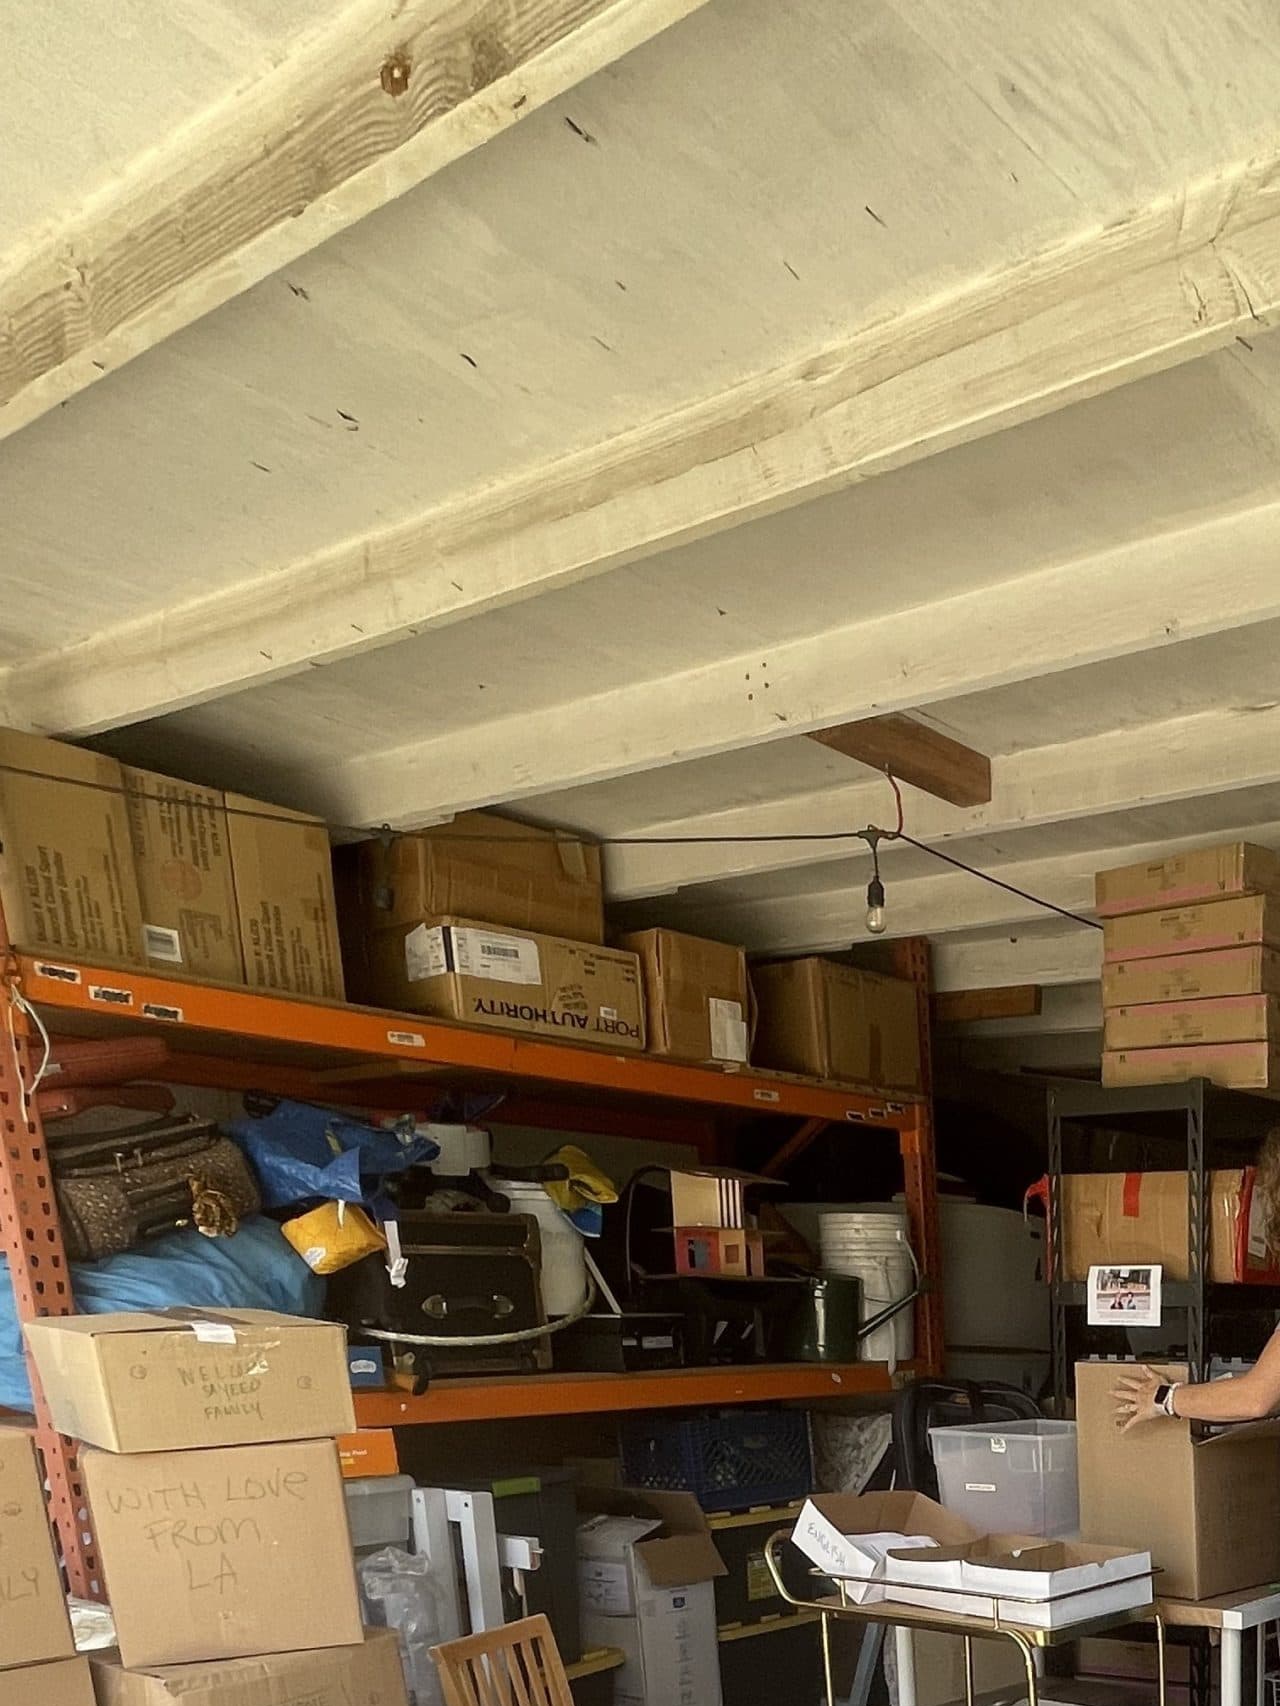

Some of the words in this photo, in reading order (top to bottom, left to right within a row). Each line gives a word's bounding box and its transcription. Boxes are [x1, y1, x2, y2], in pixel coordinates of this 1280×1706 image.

[473, 997, 588, 1028] AUTHORITY
[592, 1016, 640, 1037] PORT
[204, 1402, 264, 1420] FAMILY
[106, 1481, 206, 1514] WITH
[187, 1552, 238, 1595] LA
